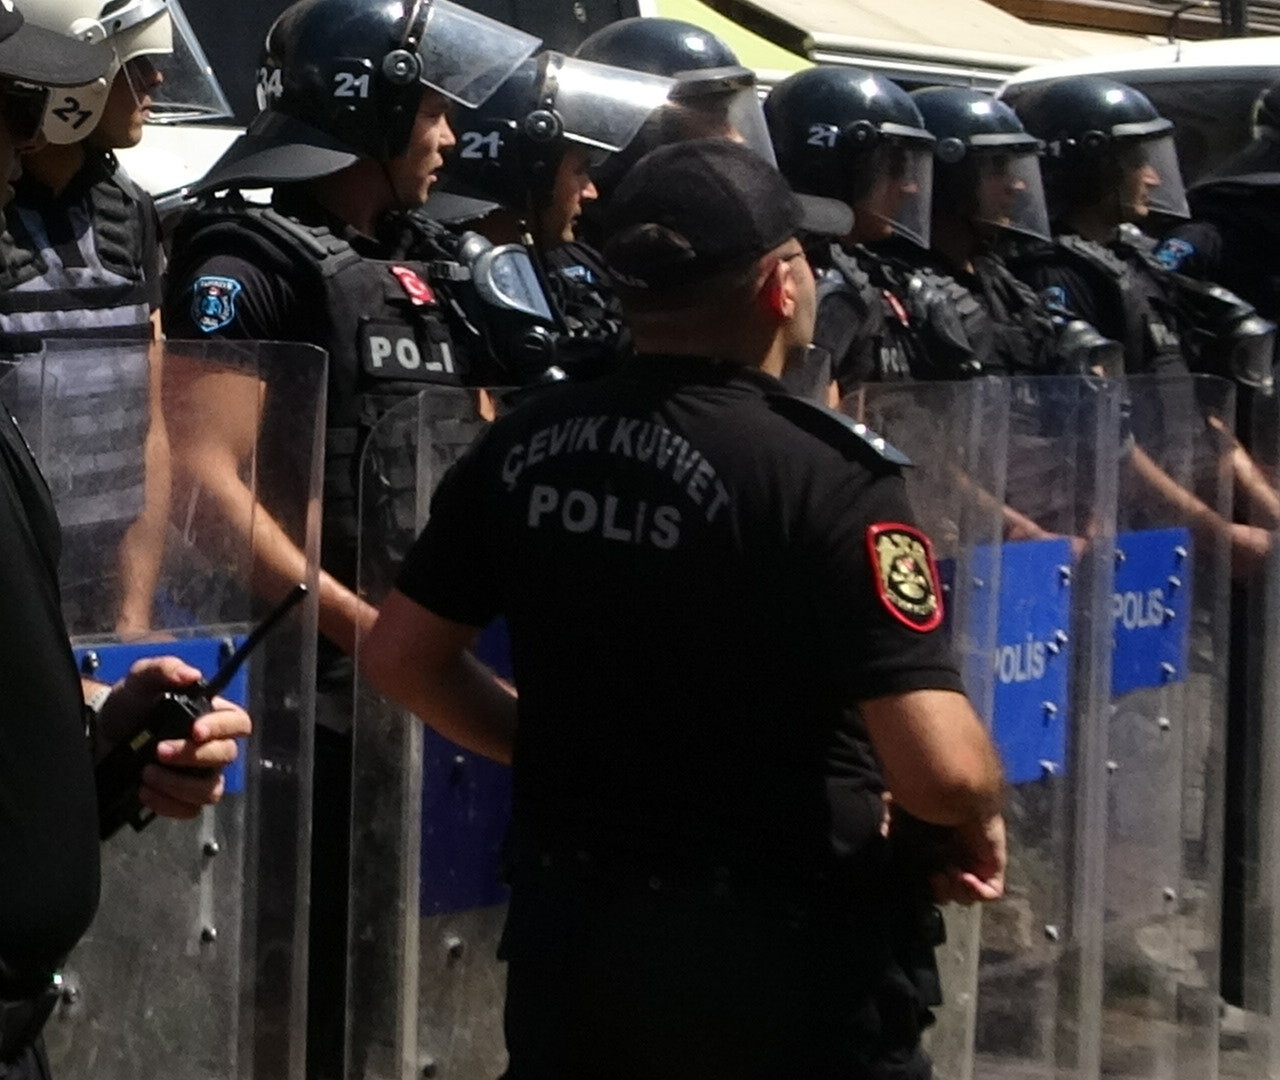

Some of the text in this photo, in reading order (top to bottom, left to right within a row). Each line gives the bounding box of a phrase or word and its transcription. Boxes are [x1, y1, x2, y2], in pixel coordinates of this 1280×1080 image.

[333, 72, 370, 98] 21
[51, 96, 93, 130] 21
[460, 130, 501, 159] 21
[609, 416, 731, 523] KUVVET
